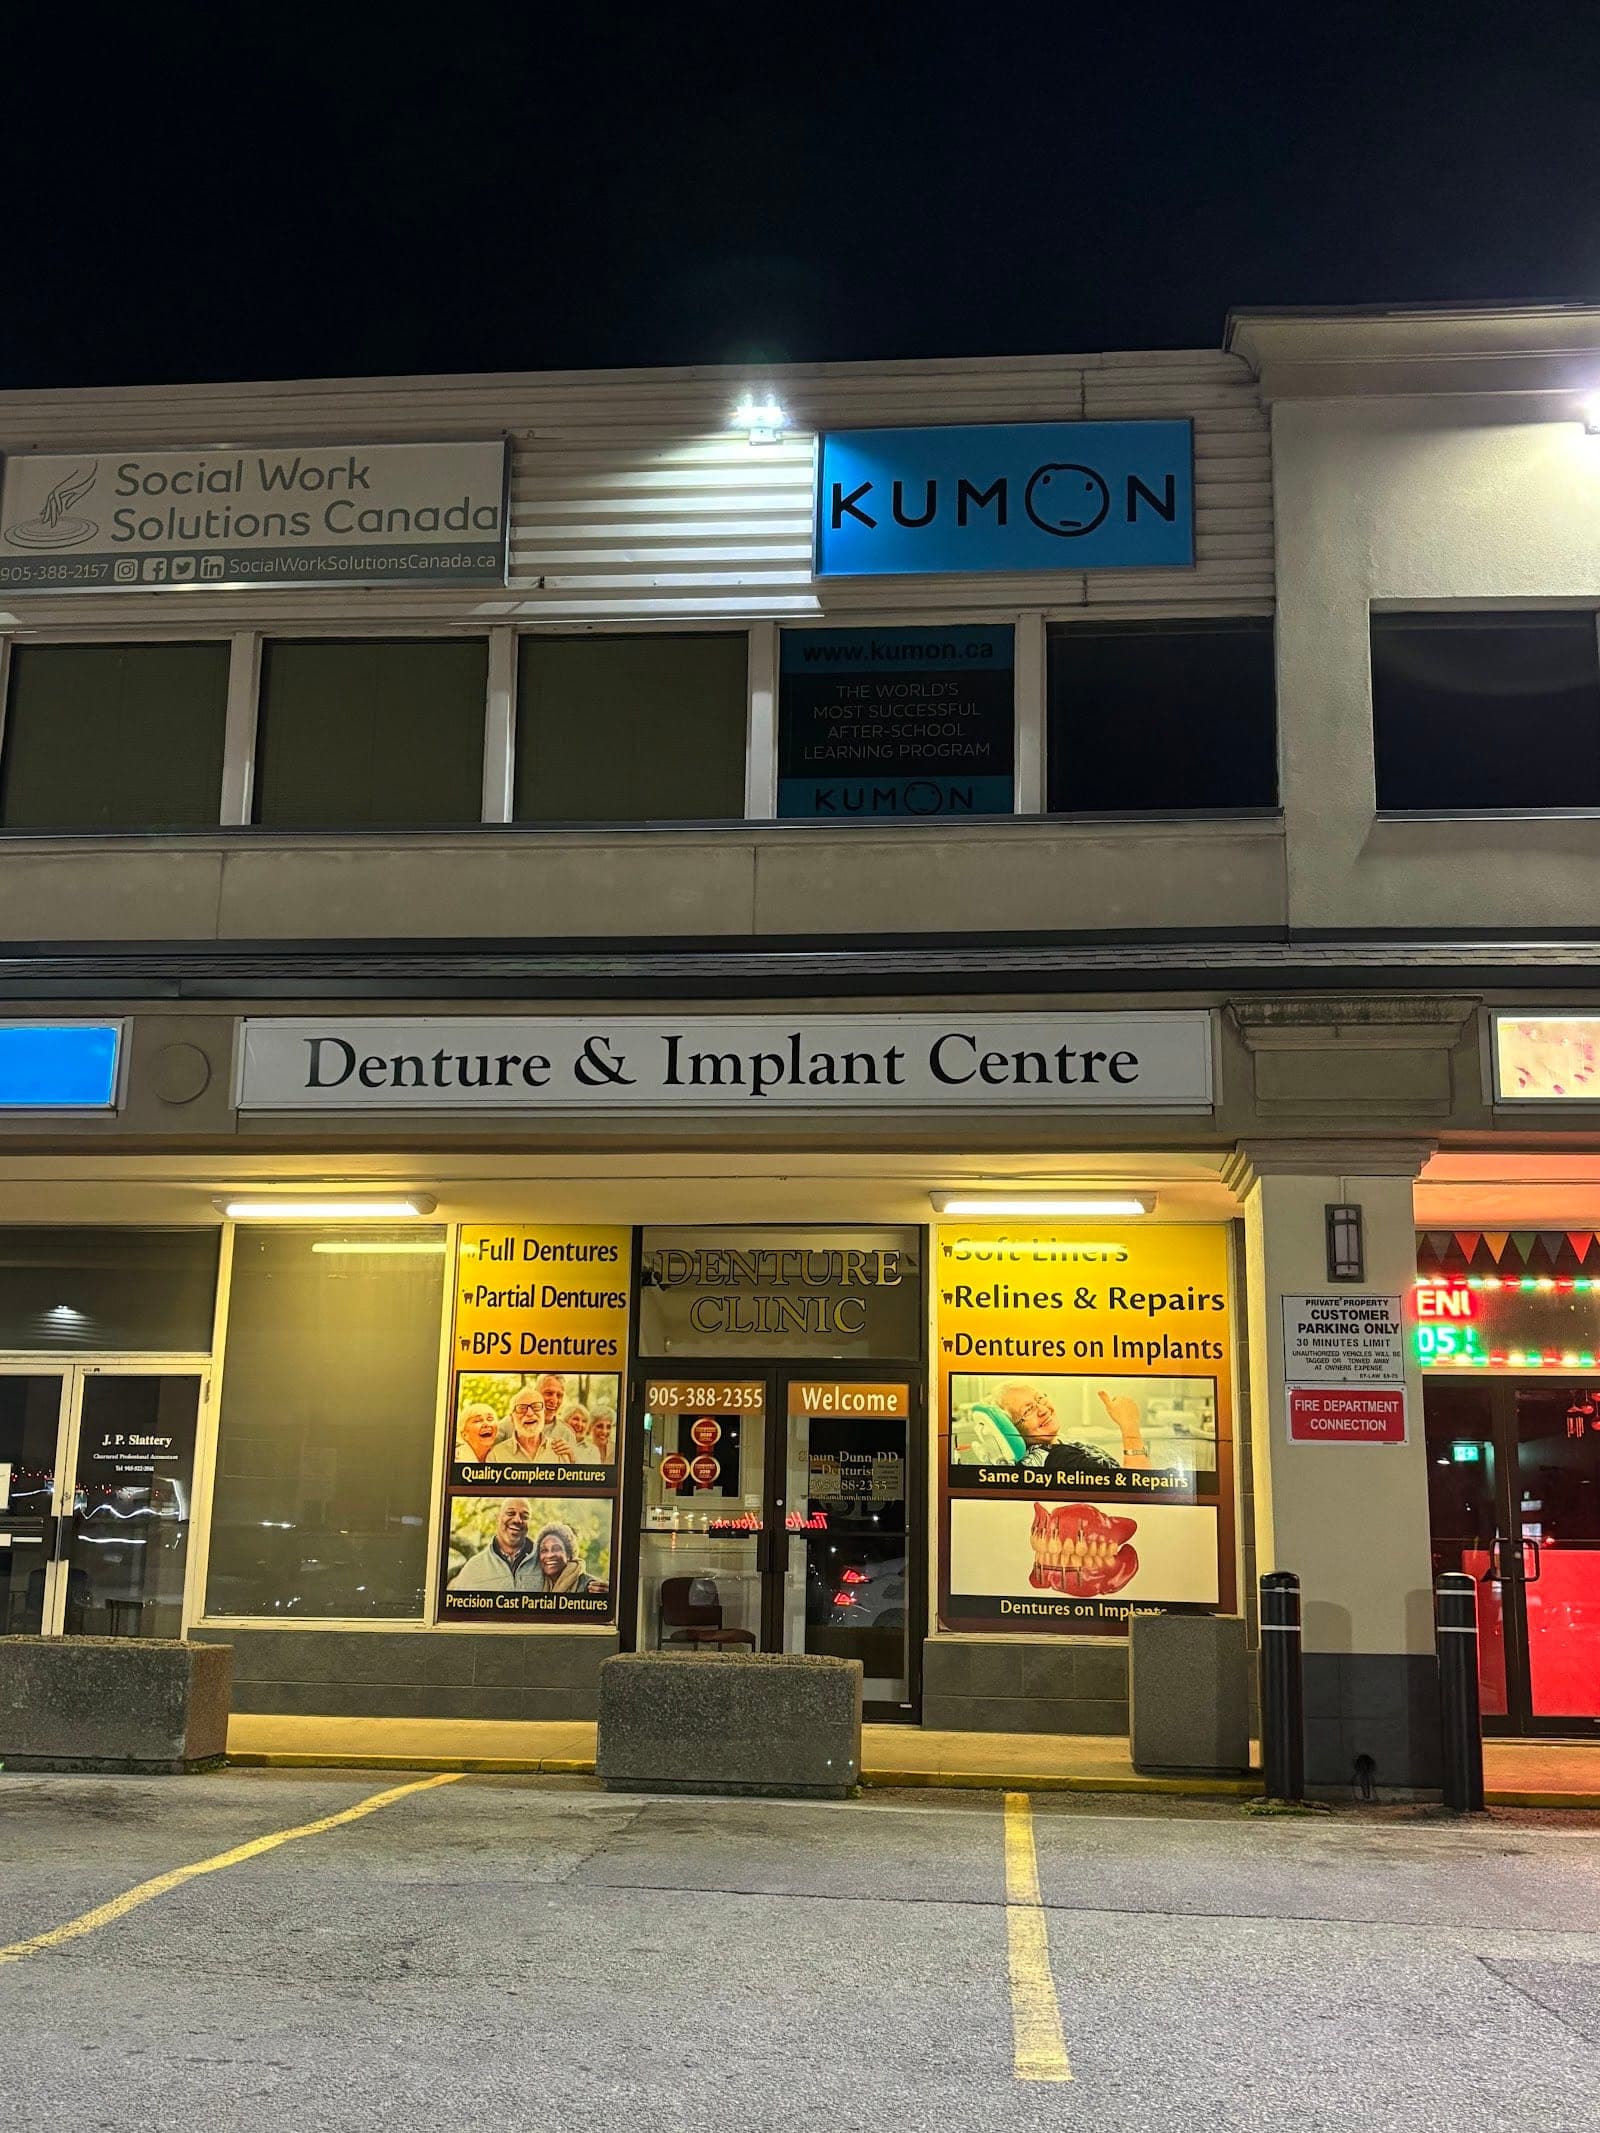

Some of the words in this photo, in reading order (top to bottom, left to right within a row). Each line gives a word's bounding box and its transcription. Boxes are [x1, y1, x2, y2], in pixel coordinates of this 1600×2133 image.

[115, 459, 244, 498] Social
[258, 456, 371, 492] Work
[831, 462, 1176, 538] KUMON
[110, 505, 311, 543] Solutions
[323, 496, 499, 536] Canada
[0, 562, 109, 582] 905-388-2157
[229, 552, 497, 575] SocialWorkSolutionsCanada.ca
[802, 640, 994, 663] www.kumon.ca
[836, 685, 871, 699] THE
[875, 682, 959, 698] WORLD'S
[813, 704, 866, 720] MOST
[868, 702, 981, 719] SUCCESSFUL
[827, 723, 966, 740] AFTER-SCHOOL
[804, 743, 894, 761] LEARNING
[899, 742, 990, 759] PROGRAM
[815, 781, 974, 816] KUMON
[303, 1036, 551, 1089] Denture
[573, 1035, 637, 1087] &
[661, 1032, 906, 1098] Implant
[929, 1033, 1139, 1086] Centre
[478, 1237, 515, 1262] Full
[523, 1238, 618, 1263] Dentures
[955, 1236, 1021, 1262] Soft
[1032, 1237, 1129, 1262] Liners
[657, 1248, 903, 1287] DENTURE
[475, 1284, 535, 1308] Partial
[541, 1285, 626, 1309] Dentures
[955, 1284, 1063, 1310] Relines
[1073, 1287, 1098, 1310] &
[1109, 1286, 1225, 1317] Repairs
[1343, 1299, 1389, 1307] PROPERTY
[690, 1296, 866, 1334] CLINIC
[1311, 1309, 1389, 1321] CUSTOMER
[1297, 1323, 1360, 1334] PARKING
[1364, 1323, 1400, 1335] ONLY
[472, 1331, 512, 1355] BPS
[520, 1332, 618, 1356] Dentures
[955, 1332, 1066, 1357] Dentures
[1073, 1340, 1104, 1358] on
[1113, 1334, 1223, 1366] Implants
[1296, 1338, 1309, 1347] 30
[1312, 1338, 1359, 1347] MINUTES
[1362, 1338, 1391, 1347] LIMIT
[648, 1387, 763, 1408] 905-388-2355
[801, 1386, 898, 1412] Welcome
[1295, 1399, 1320, 1412] FIRE
[1323, 1399, 1399, 1413] DEPARTMENT
[1310, 1418, 1387, 1432] CONNECTION
[102, 1434, 111, 1446] J.
[115, 1434, 125, 1446] P.
[128, 1434, 173, 1448] Slattery
[839, 1450, 872, 1463] Dunn
[877, 1451, 899, 1463] DD
[461, 1466, 502, 1483] Quality
[503, 1467, 556, 1484] Complete
[557, 1467, 606, 1482] Dentures
[978, 1468, 1020, 1485] Same
[1023, 1469, 1052, 1488] Day
[1056, 1470, 1110, 1486] Relines
[1115, 1472, 1128, 1487] &
[1131, 1472, 1189, 1491] Repairs
[445, 1594, 494, 1609] Precision
[495, 1595, 519, 1609] Cast
[521, 1595, 557, 1610] Partial
[559, 1596, 608, 1611] Dentures
[1000, 1599, 1070, 1617] Dentures
[1074, 1605, 1096, 1617] on
